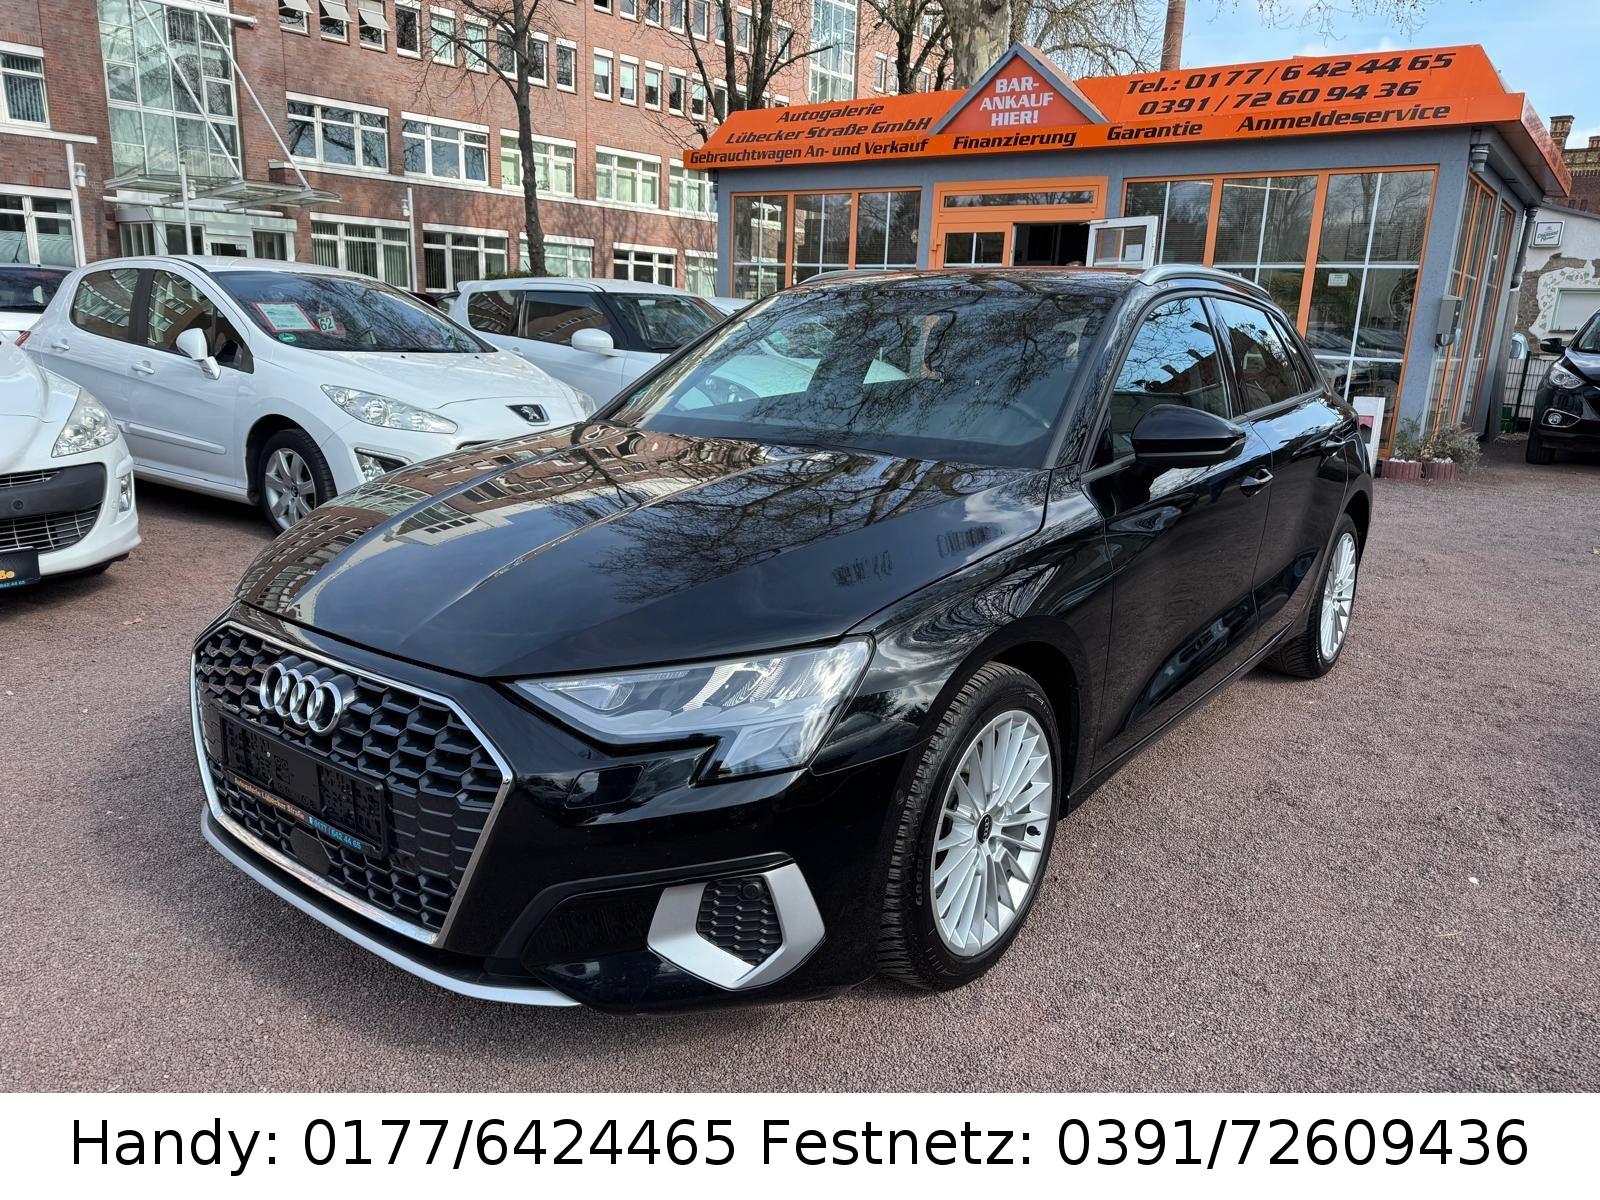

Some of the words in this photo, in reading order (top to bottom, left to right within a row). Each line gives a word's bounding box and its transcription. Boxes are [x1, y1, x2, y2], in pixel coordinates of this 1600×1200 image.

[1127, 77, 1181, 95] Tel.:
[1185, 69, 1264, 90] 0177
[1307, 61, 1352, 78] 42
[1356, 57, 1403, 74] 44
[1408, 53, 1457, 71] 65
[995, 76, 1040, 94] BAR-
[980, 92, 1054, 111] ANKAUF
[1138, 97, 1212, 116] 0391
[1233, 91, 1273, 109] 72
[1276, 88, 1321, 105] 60
[1323, 84, 1370, 102] 94
[1374, 80, 1422, 98] 36
[776, 103, 885, 123] Autogalerie
[991, 110, 1039, 127] HIER!
[1236, 104, 1452, 133] Anmeldeservice
[725, 130, 806, 144] Lübecker
[805, 123, 869, 139] Straße
[870, 117, 933, 134] GmbH
[953, 131, 1078, 150] Finanzierung
[1106, 120, 1203, 141] Garantie
[690, 147, 802, 163] Gebrauchtwagen
[804, 144, 829, 158] An-
[831, 142, 862, 157] und
[864, 138, 930, 155] Verkauf
[319, 317, 334, 331] 62
